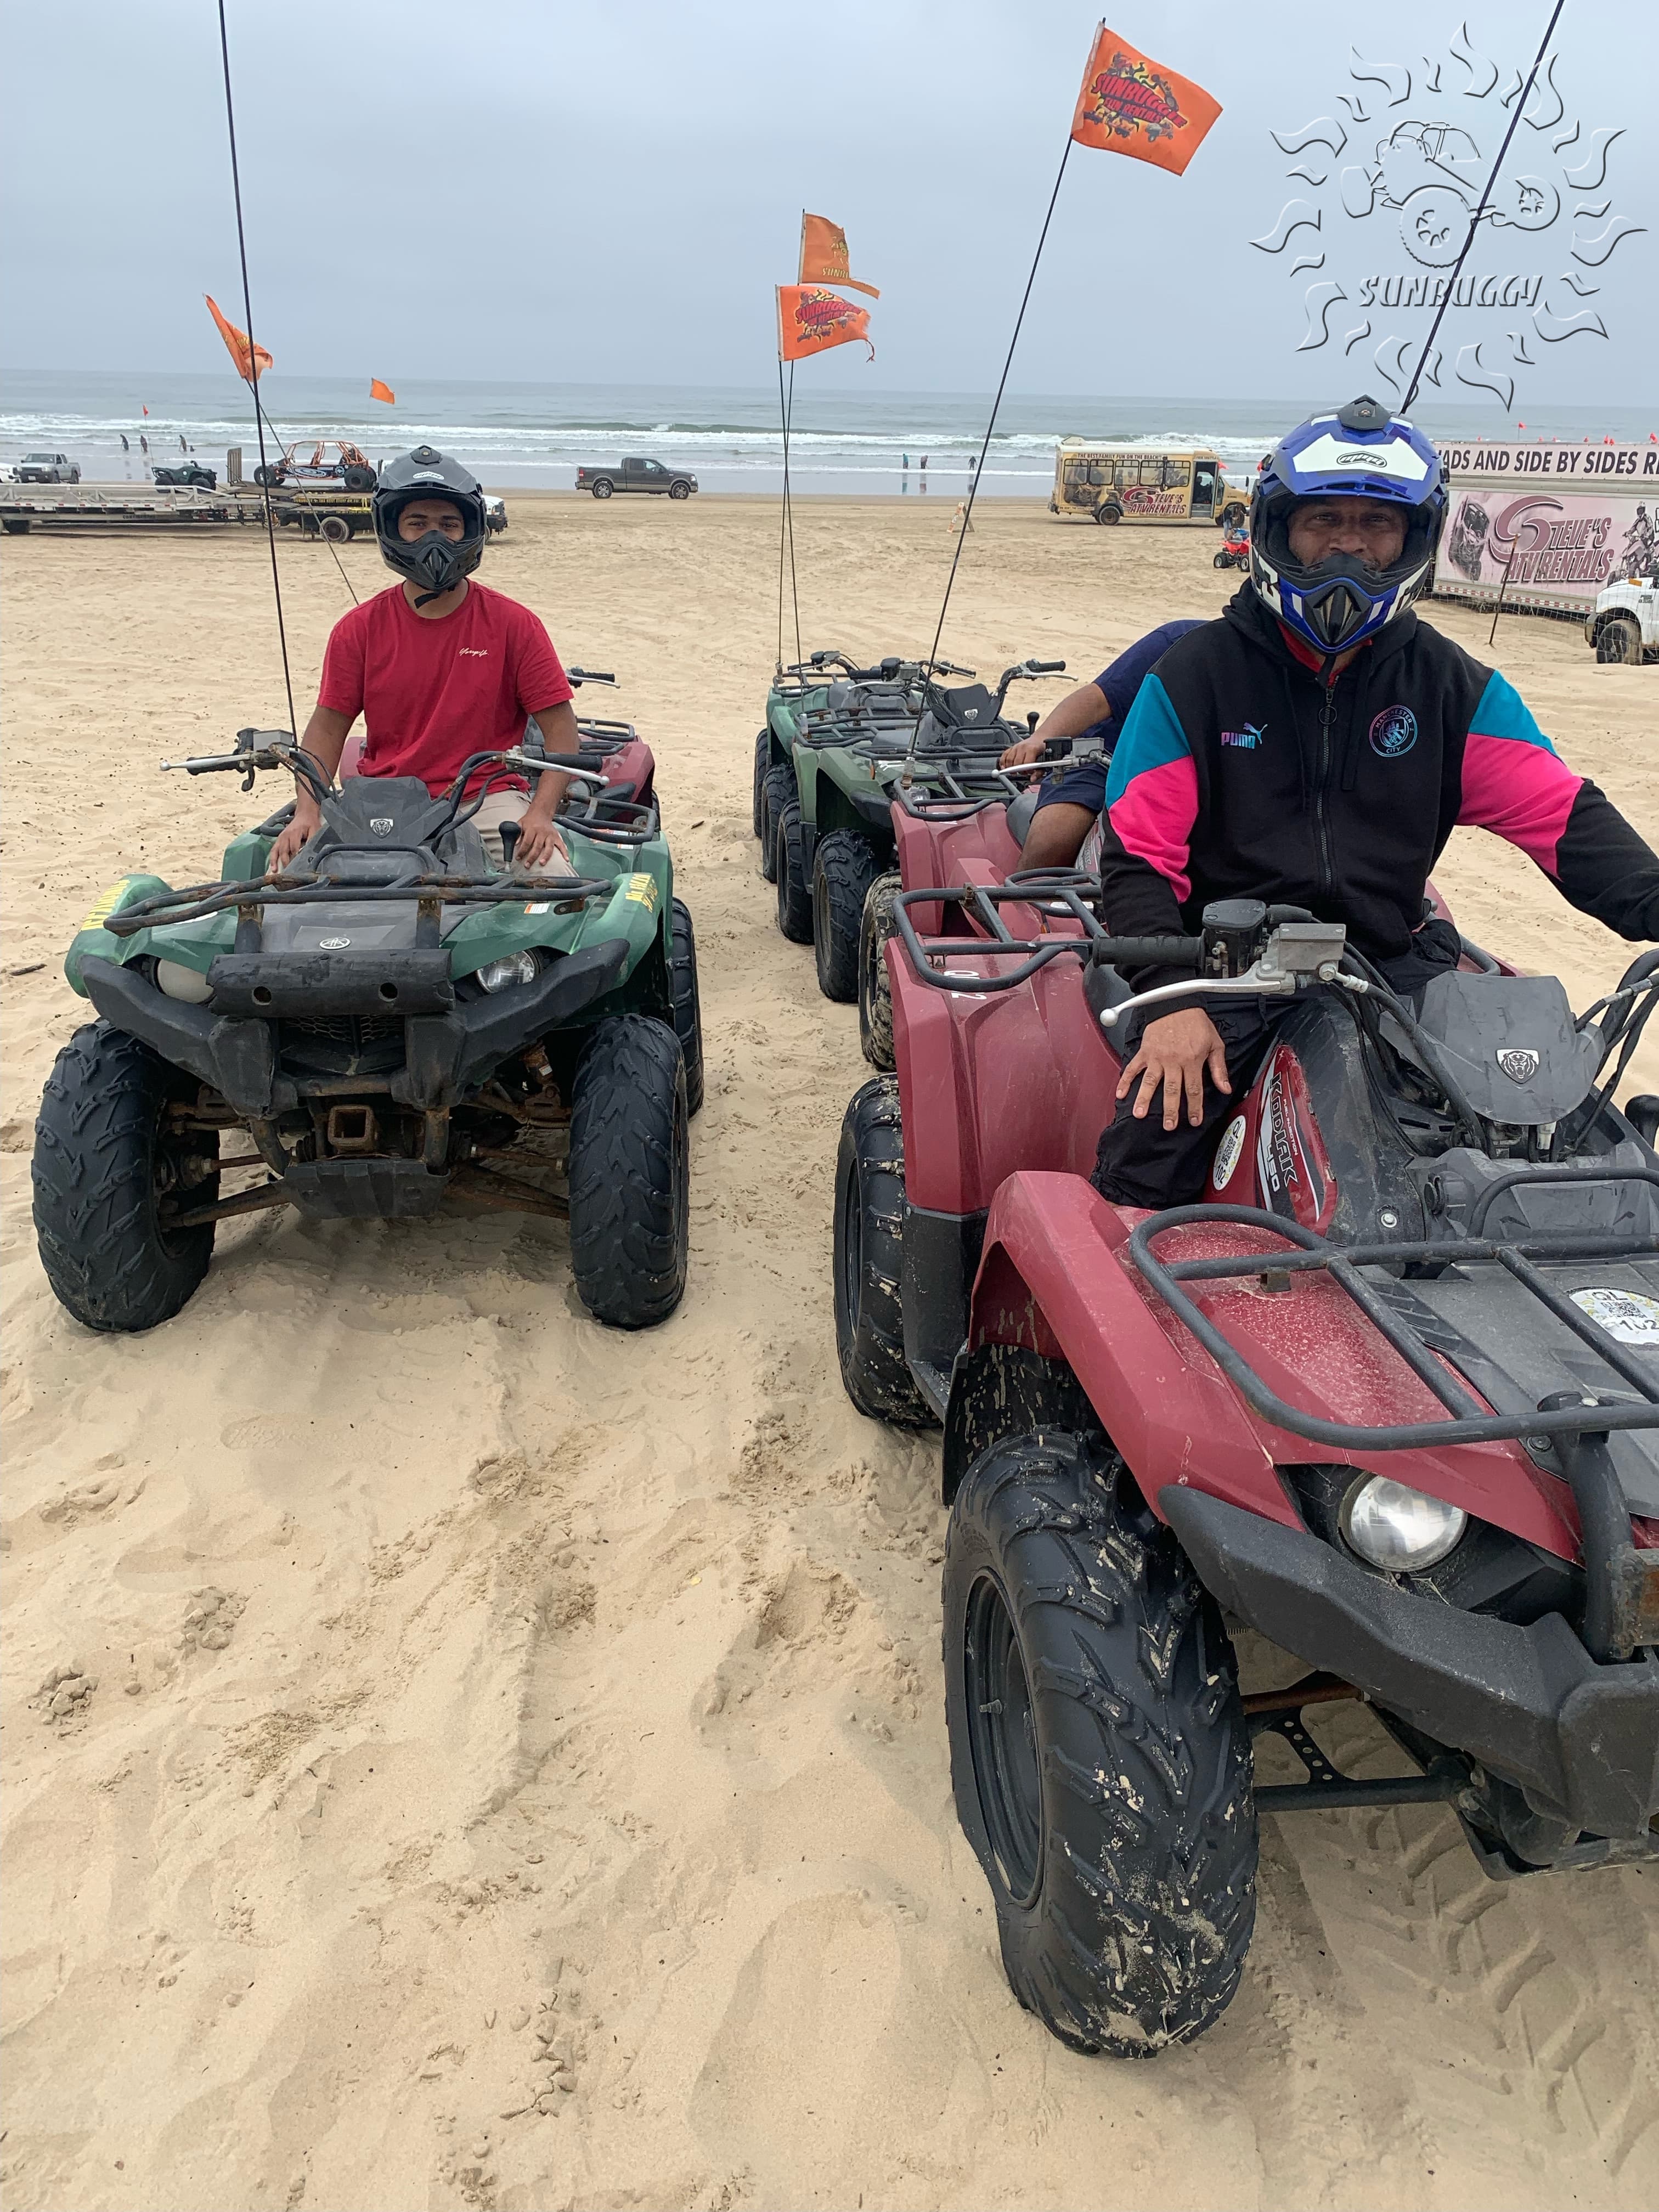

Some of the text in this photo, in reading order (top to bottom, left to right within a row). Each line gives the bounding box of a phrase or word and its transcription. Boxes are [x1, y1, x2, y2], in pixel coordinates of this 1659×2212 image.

[1438, 449, 1471, 470] ADS
[1473, 449, 1510, 471] AND
[1514, 450, 1553, 472] SIDE
[1556, 451, 1582, 473] BY
[1583, 451, 1639, 475] SIDES
[1120, 487, 1184, 508] STEVE'S
[1130, 503, 1187, 514] ATV RENTALS
[1489, 495, 1612, 562] STEVE'S
[1502, 549, 1615, 582] ATV RENTALS
[1375, 709, 1413, 728] MANCHESTER
[1221, 732, 1255, 749] PUMA
[1233, 1121, 1242, 1139] QL
[1269, 1071, 1299, 1188] KODIAK
[1286, 1118, 1299, 1156] INJECTION
[1215, 1164, 1227, 1184] 102
[1266, 1144, 1280, 1192] 450
[1592, 1291, 1628, 1301] QL
